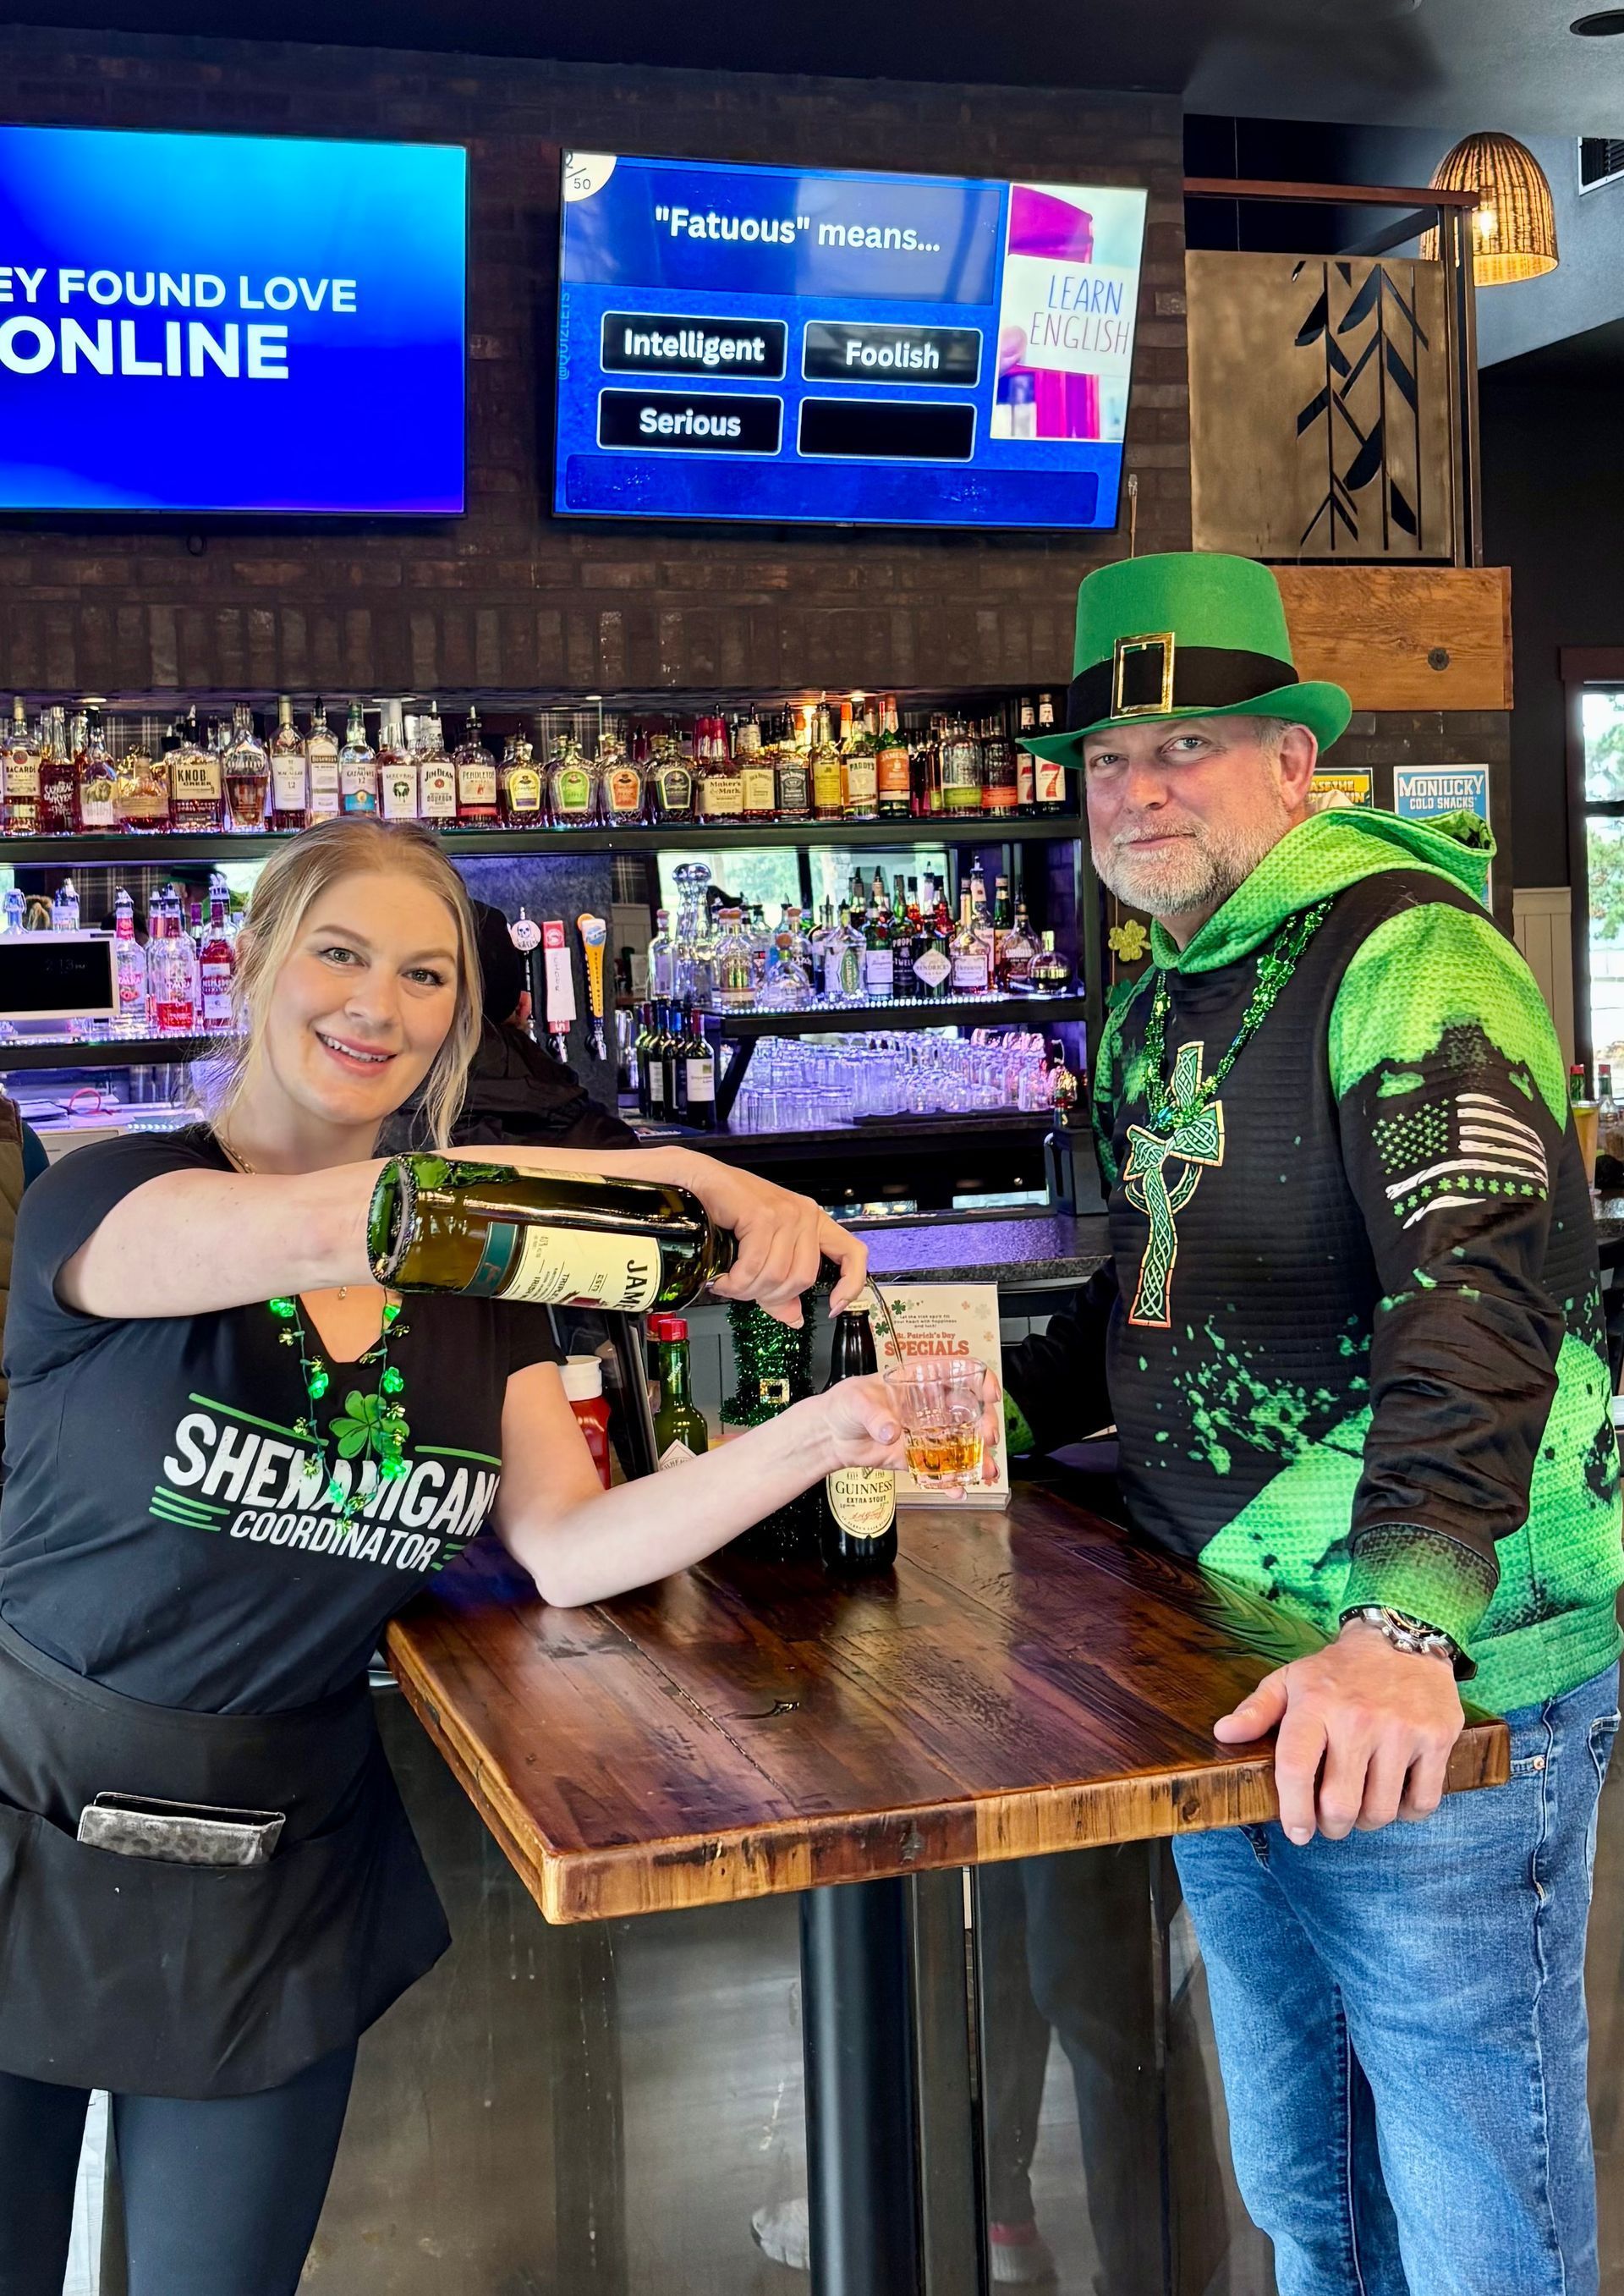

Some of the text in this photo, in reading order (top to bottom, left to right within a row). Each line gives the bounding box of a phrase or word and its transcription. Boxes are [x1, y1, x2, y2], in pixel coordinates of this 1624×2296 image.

[573, 178, 591, 190] 50
[655, 206, 941, 252] "Fatuous" means...
[59, 270, 226, 308] FOUND
[239, 276, 357, 312] LOVE
[1048, 275, 1123, 315] LEARN
[0, 316, 288, 379] ONLINE
[624, 329, 765, 365] Intelligent
[1029, 312, 1130, 354] ENGLISH
[846, 339, 939, 369] Foolish
[639, 408, 741, 437] Serious
[178, 769, 206, 782] KNOB
[425, 770, 436, 782] JIM
[1040, 763, 1061, 798] 7
[1398, 774, 1484, 797] MONTUCKY
[1409, 796, 1473, 810] COLD SNACKS
[613, 1260, 648, 1310] JAME
[884, 1339, 969, 1356] SPECIALS
[942, 1332, 956, 1340] Day
[163, 1413, 501, 1537] SHENANIGAN
[836, 1480, 892, 1495] GUINNESS
[869, 1495, 886, 1503] STOUT
[229, 1509, 441, 1573] COORDINATOR
